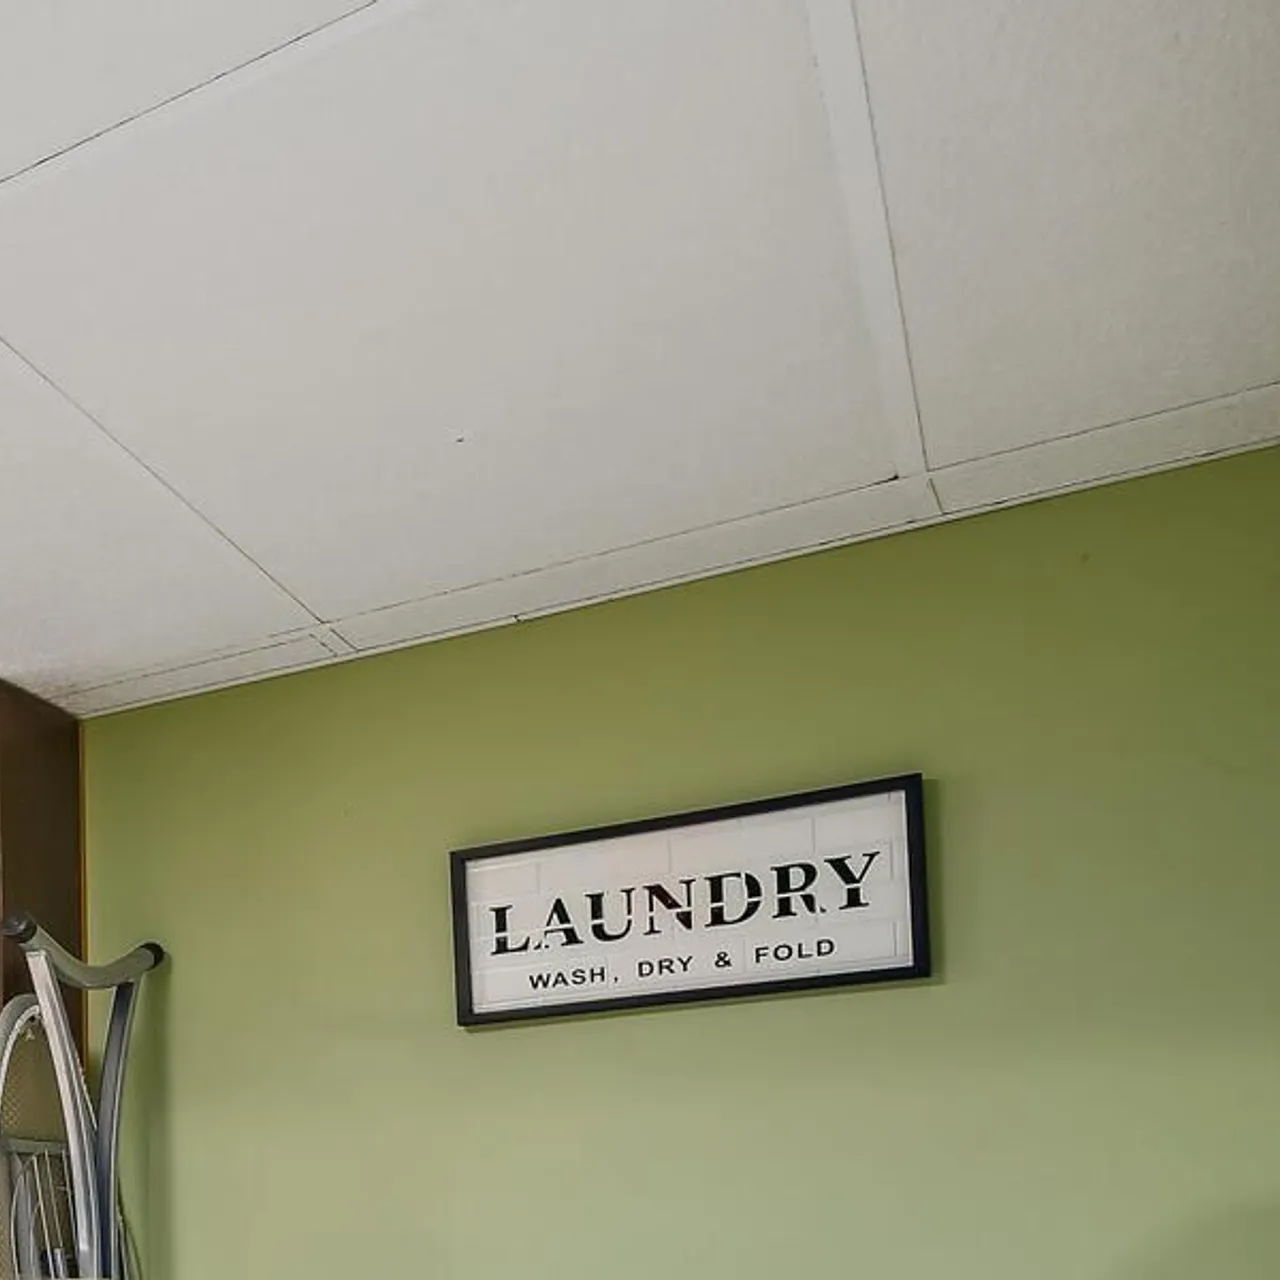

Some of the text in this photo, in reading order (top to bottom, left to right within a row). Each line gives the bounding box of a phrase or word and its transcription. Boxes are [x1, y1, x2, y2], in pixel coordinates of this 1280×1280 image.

[488, 850, 880, 956] LAUNDRY
[529, 938, 836, 991] WASH, DRY & FOLD
